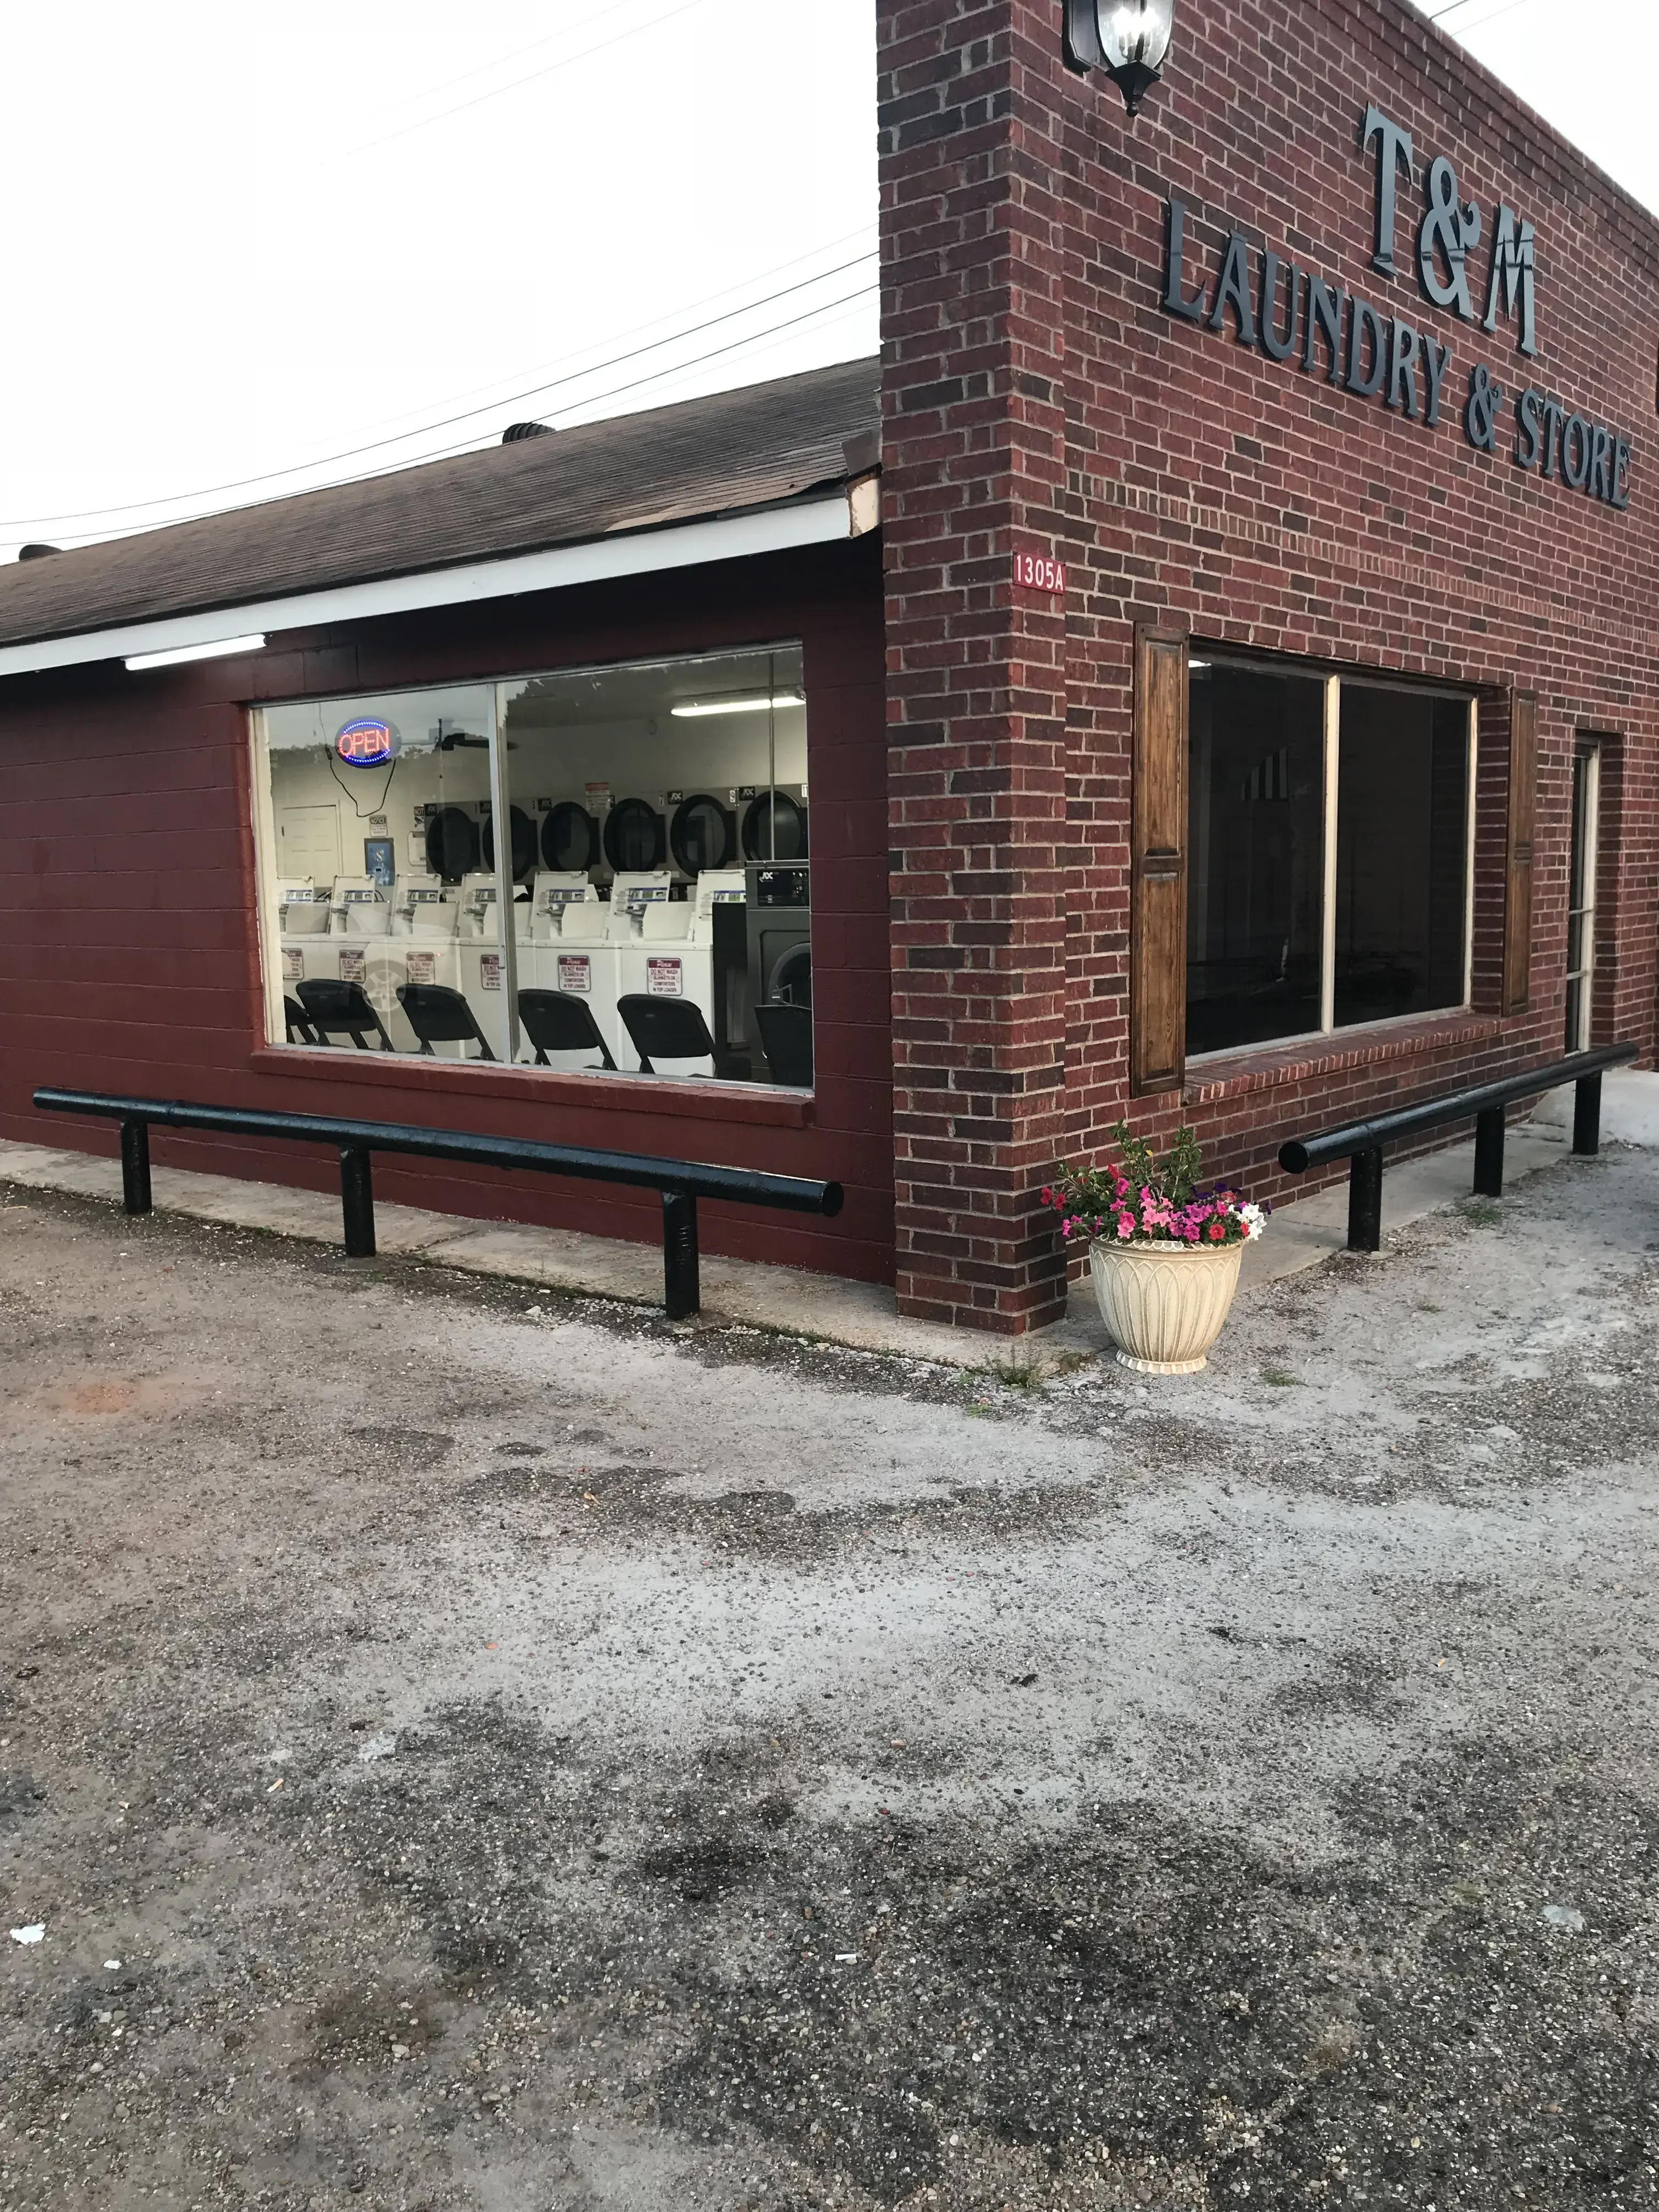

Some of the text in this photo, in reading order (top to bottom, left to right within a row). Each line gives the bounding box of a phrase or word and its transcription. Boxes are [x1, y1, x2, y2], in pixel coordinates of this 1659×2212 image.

[1164, 198, 1630, 507] LAUNDRY & STORE
[1017, 555, 1063, 591] 1305A
[338, 728, 390, 755] OPEN
